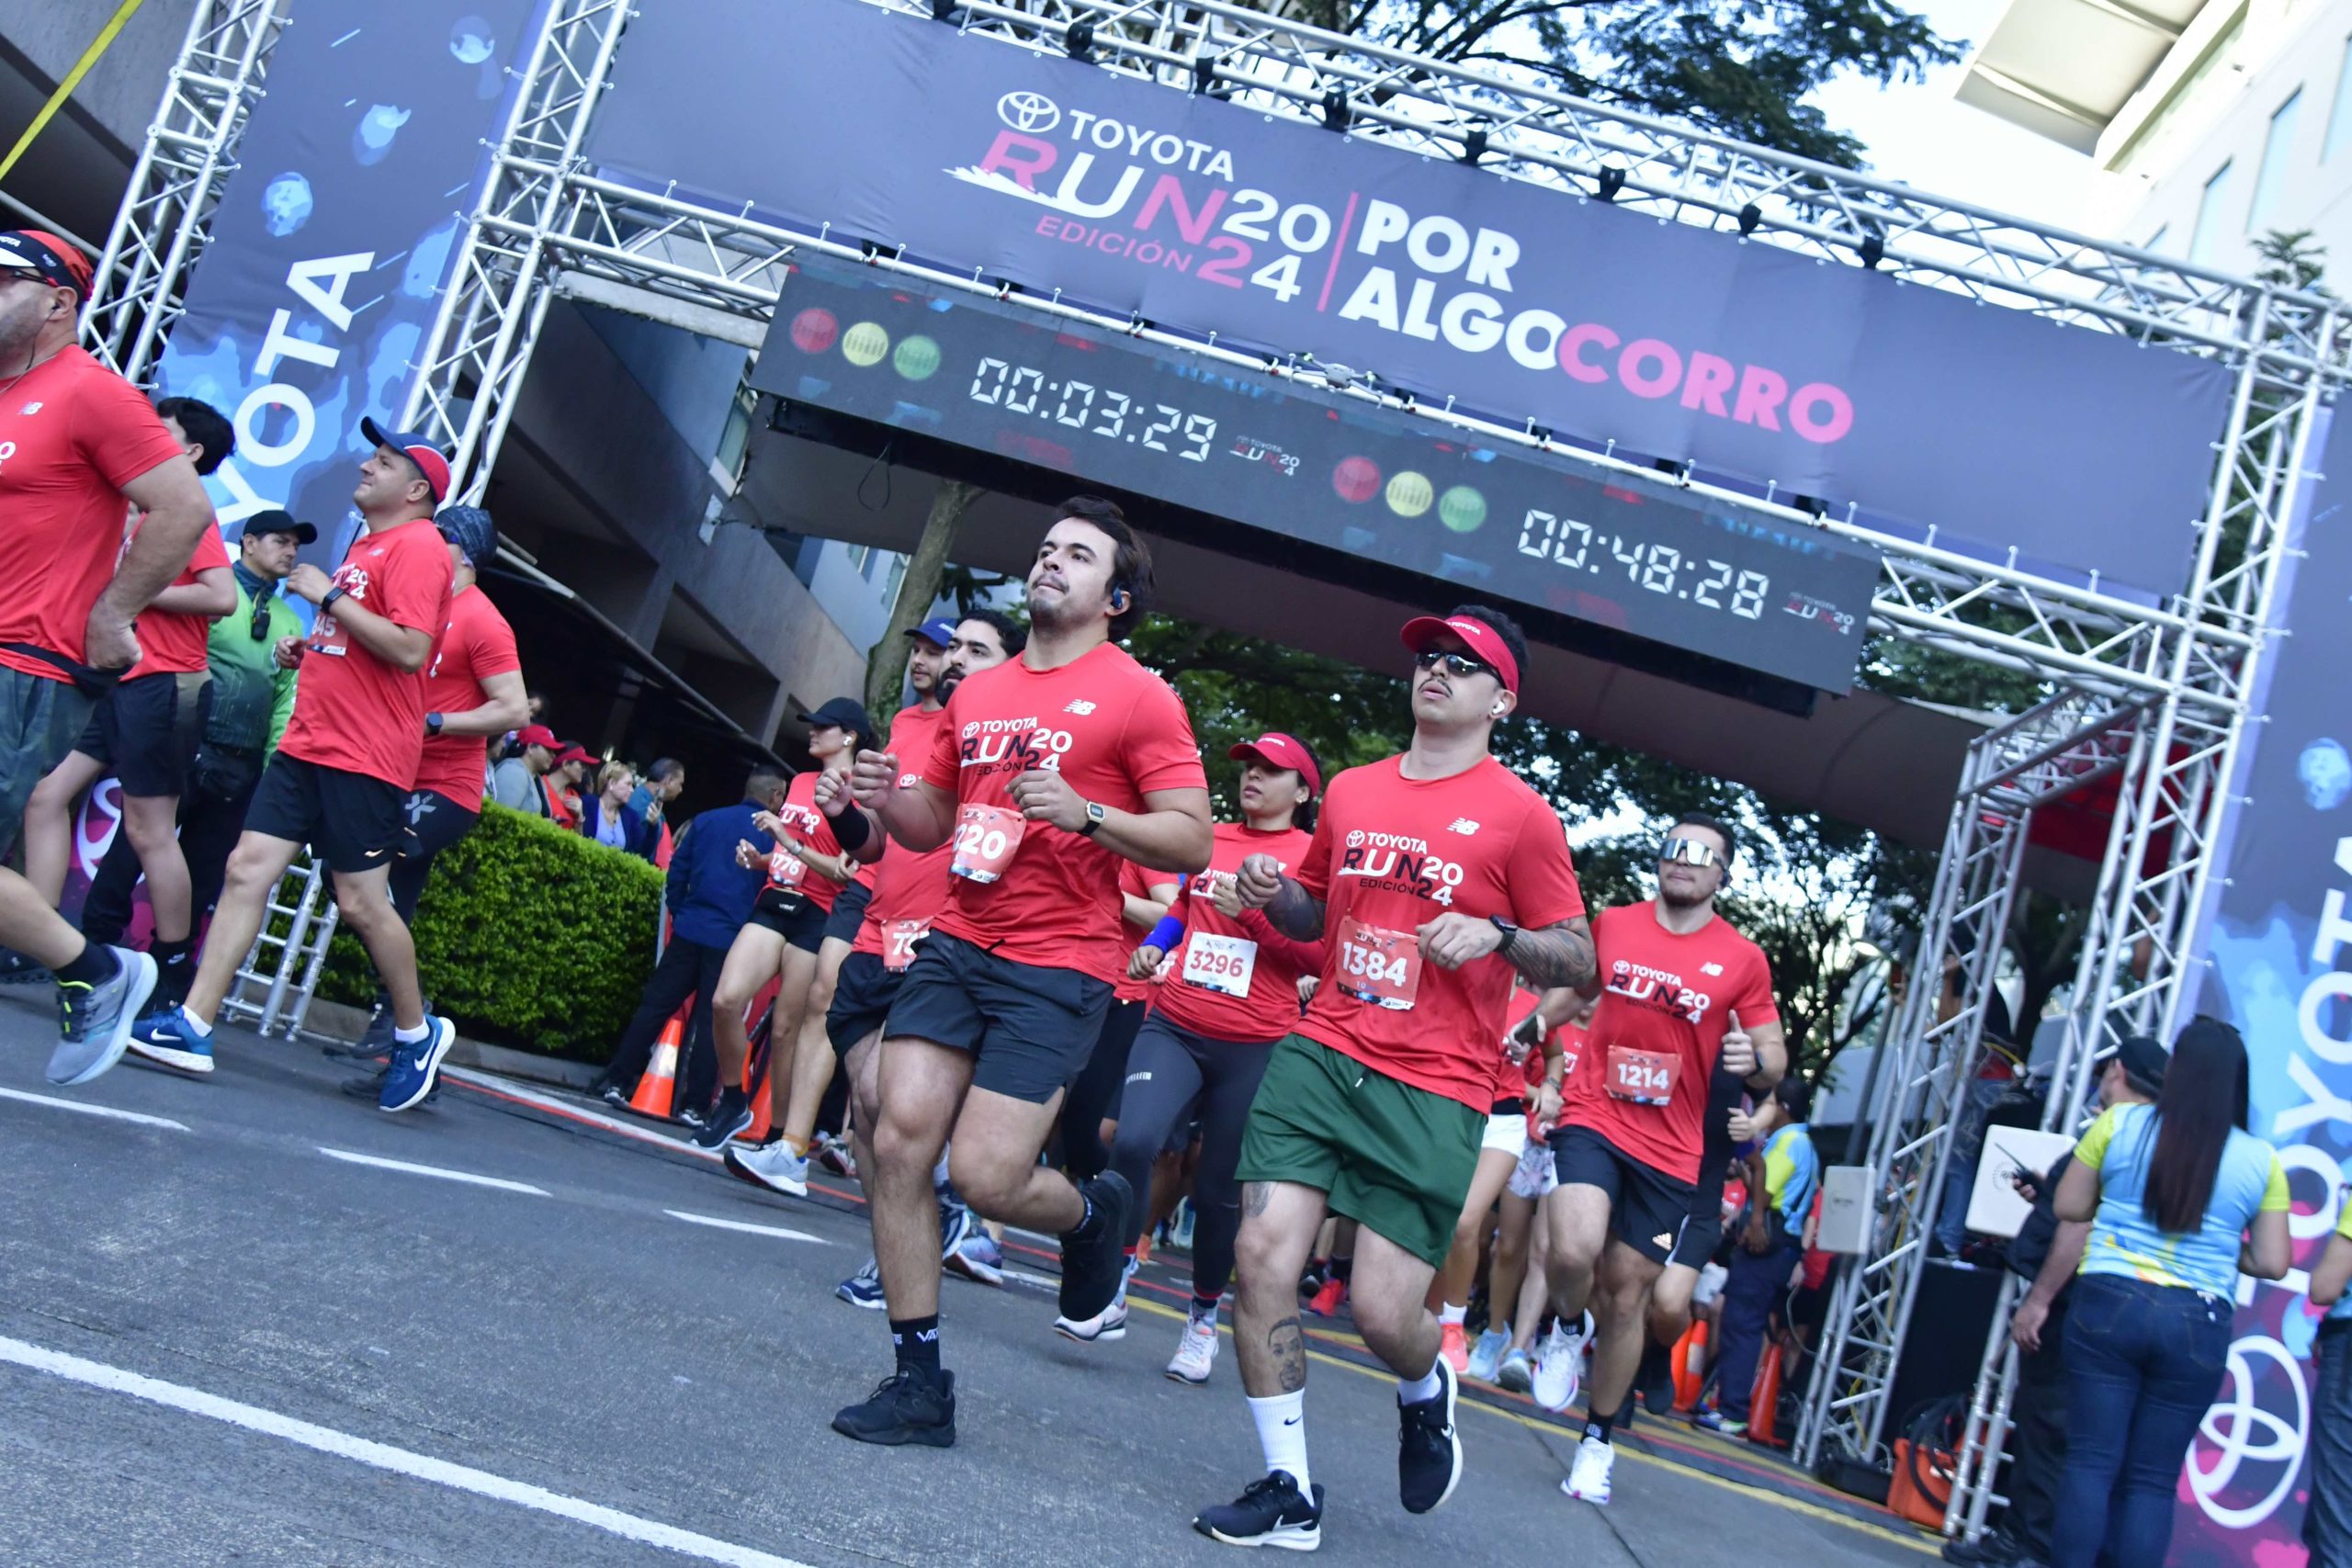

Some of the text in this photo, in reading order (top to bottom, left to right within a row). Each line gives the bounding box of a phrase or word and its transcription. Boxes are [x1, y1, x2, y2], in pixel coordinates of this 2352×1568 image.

[1069, 108, 1234, 183] TOYOTA
[944, 129, 1331, 254] RUN 20
[1035, 214, 1302, 303] EDICIÓN 24
[1356, 198, 1521, 293] POR
[970, 356, 1217, 462] 00:03:29
[1518, 509, 1770, 621] 00:48:28
[982, 716, 1038, 734] TOYOTA
[960, 728, 1073, 768] RUN 20
[1367, 831, 1428, 854] TOYOTA
[1337, 848, 1464, 886] RUN 20
[1359, 876, 1453, 907] EDICIÓN 24
[1190, 949, 1244, 977] 3296
[1342, 942, 1408, 987] 1384
[1631, 964, 1682, 987] TOYOTA
[1605, 973, 1710, 1011] RUN 20
[1672, 1003, 1702, 1025] 24
[1617, 1063, 1669, 1090] 1214
